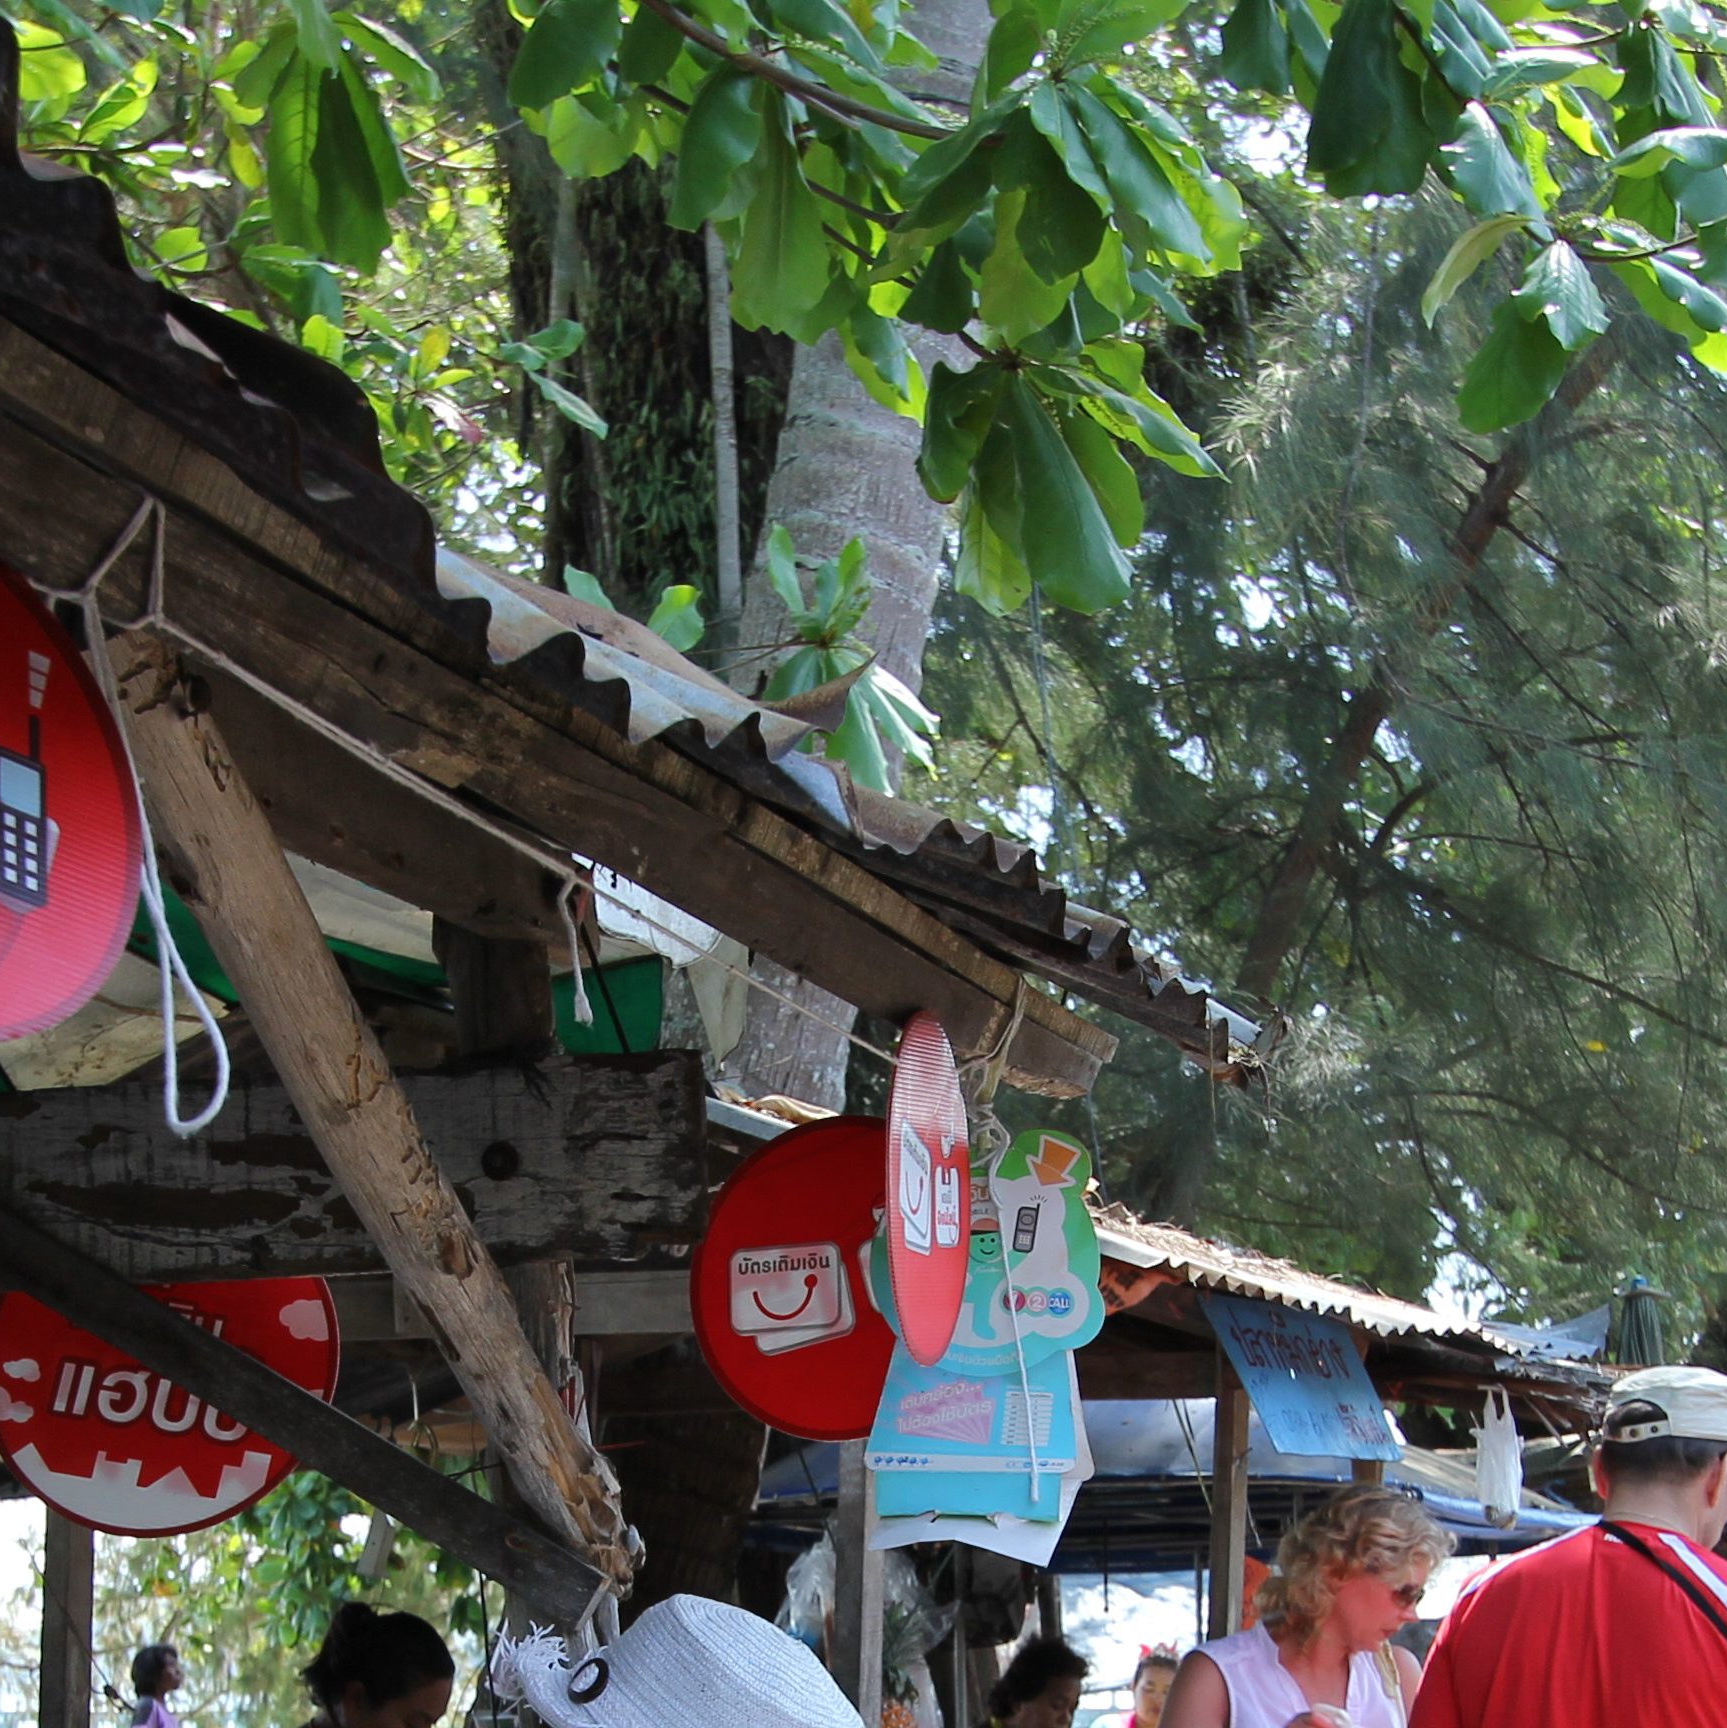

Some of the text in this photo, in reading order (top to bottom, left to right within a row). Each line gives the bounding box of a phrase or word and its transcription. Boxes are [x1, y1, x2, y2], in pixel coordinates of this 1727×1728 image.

[738, 1252, 831, 1276] บัตรเติมเงิน
